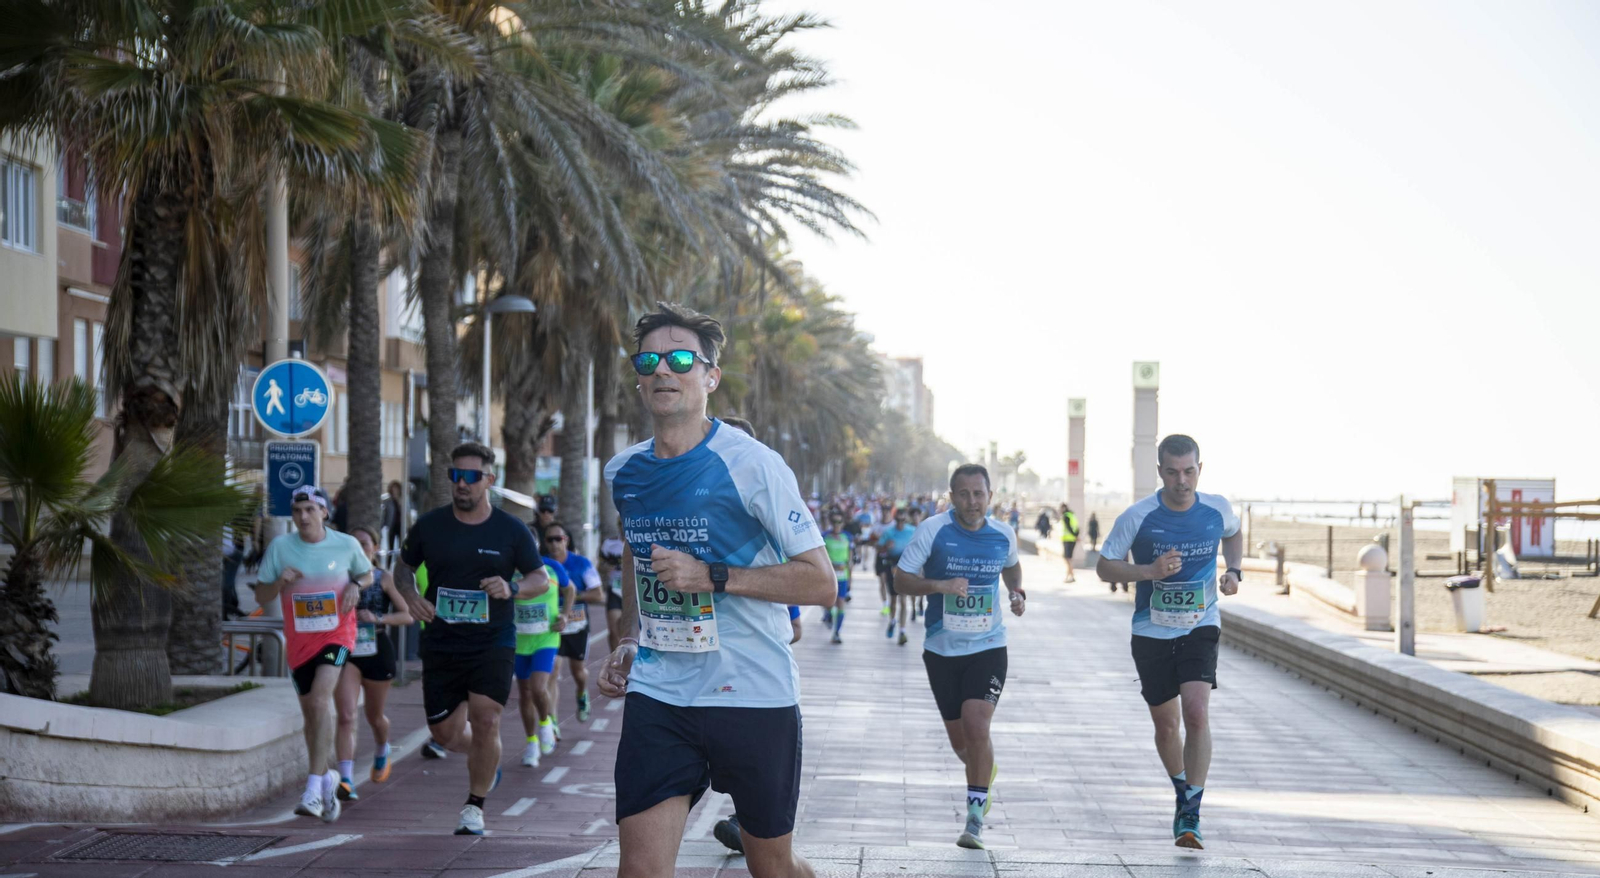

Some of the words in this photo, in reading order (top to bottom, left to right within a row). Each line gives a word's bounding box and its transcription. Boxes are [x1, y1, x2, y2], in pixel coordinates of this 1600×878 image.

[269, 444, 313, 452] PRIORIDAD
[624, 517, 651, 528] Medio
[654, 516, 709, 527] Maratón
[625, 530, 670, 543] Almería
[672, 528, 709, 542] 2025
[1152, 542, 1179, 551] Medio
[1181, 540, 1215, 549] Maratón
[1189, 546, 1214, 557] 2025
[946, 556, 971, 564] Medio
[946, 562, 980, 571] Almería
[980, 564, 1001, 573] 2025
[955, 595, 985, 609] 601
[1161, 591, 1195, 605] 652
[306, 600, 324, 612] 64
[447, 599, 479, 614] 177
[518, 609, 545, 619] 2528
